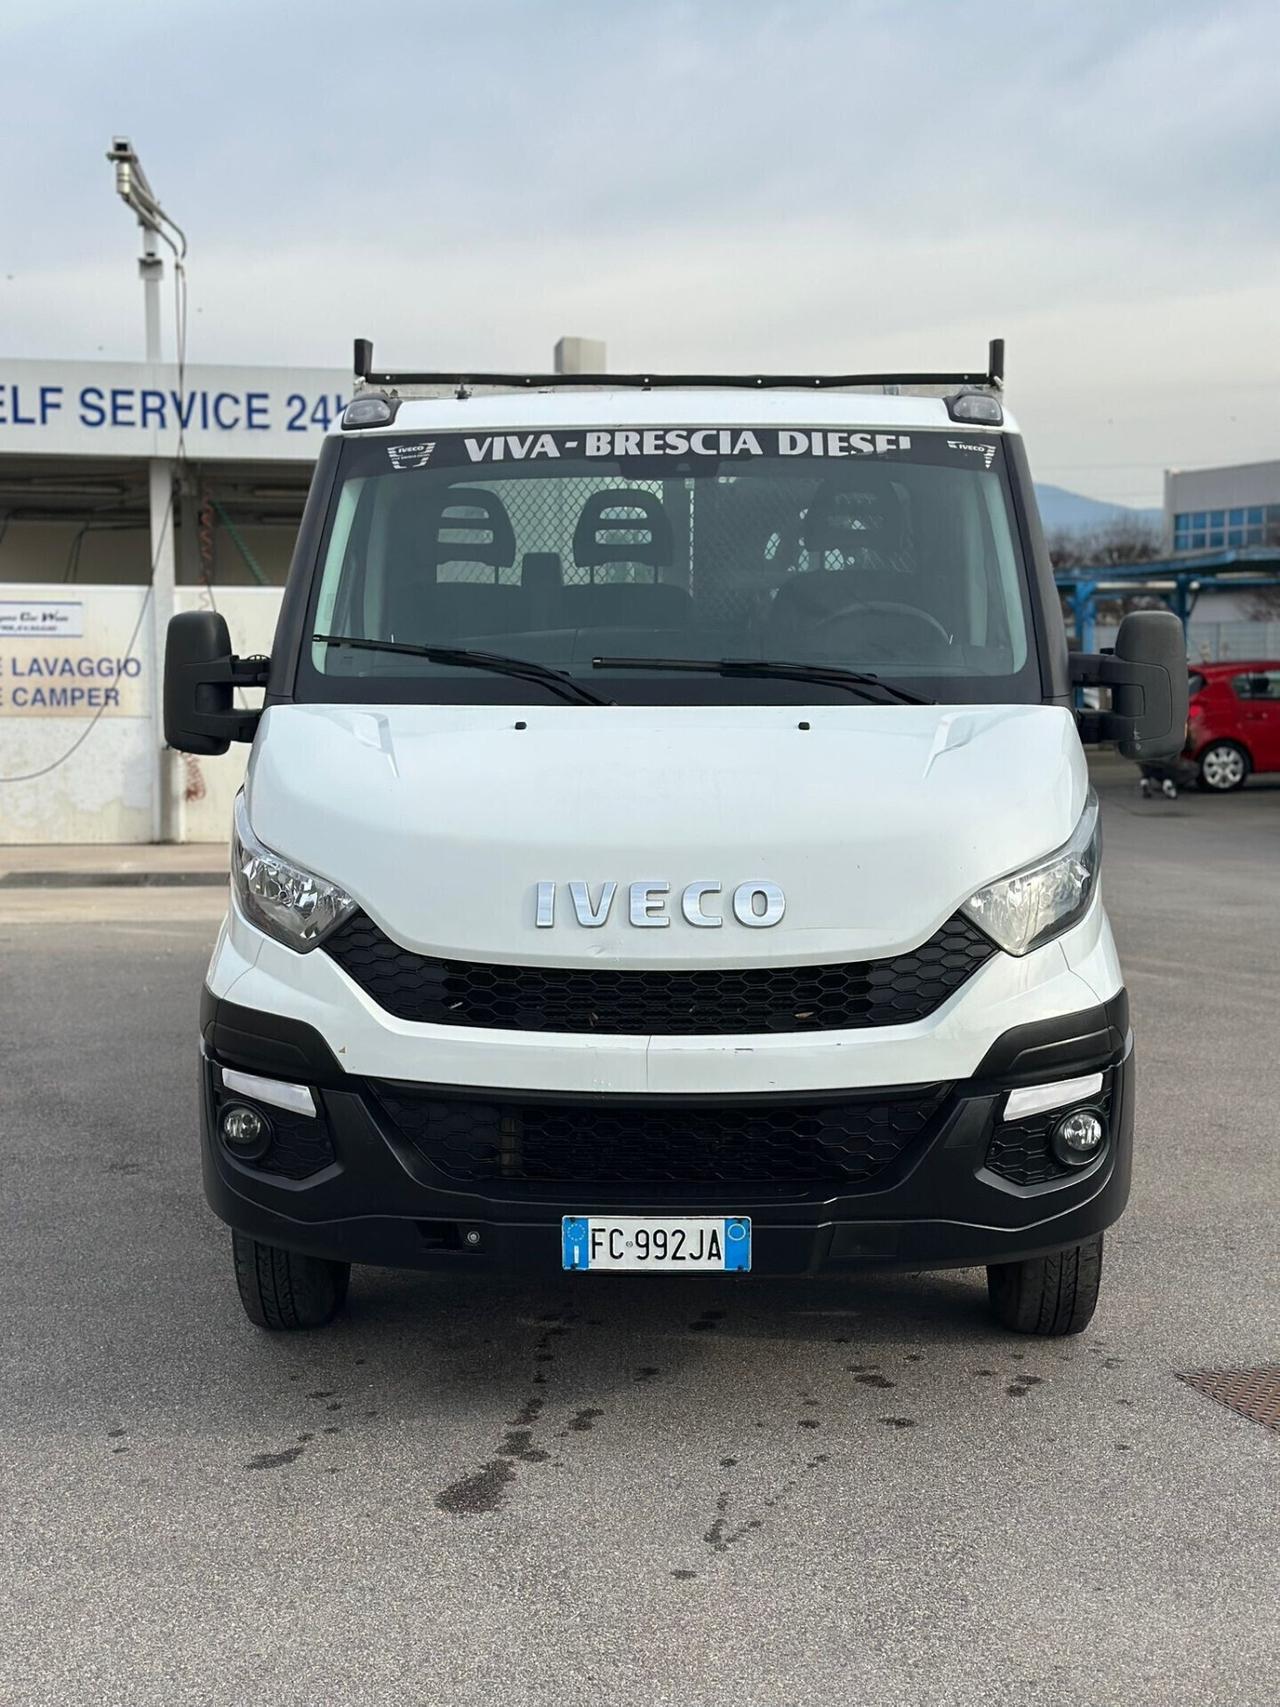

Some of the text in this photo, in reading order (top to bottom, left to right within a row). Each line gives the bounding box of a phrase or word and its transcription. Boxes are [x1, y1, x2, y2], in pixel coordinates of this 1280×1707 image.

[0, 385, 63, 425] LF
[79, 387, 270, 430] SERVICE
[959, 444, 985, 452] IVECO
[11, 657, 141, 678] LAVAGGIO
[12, 687, 119, 707] CAMPER
[536, 881, 786, 928] IVECO
